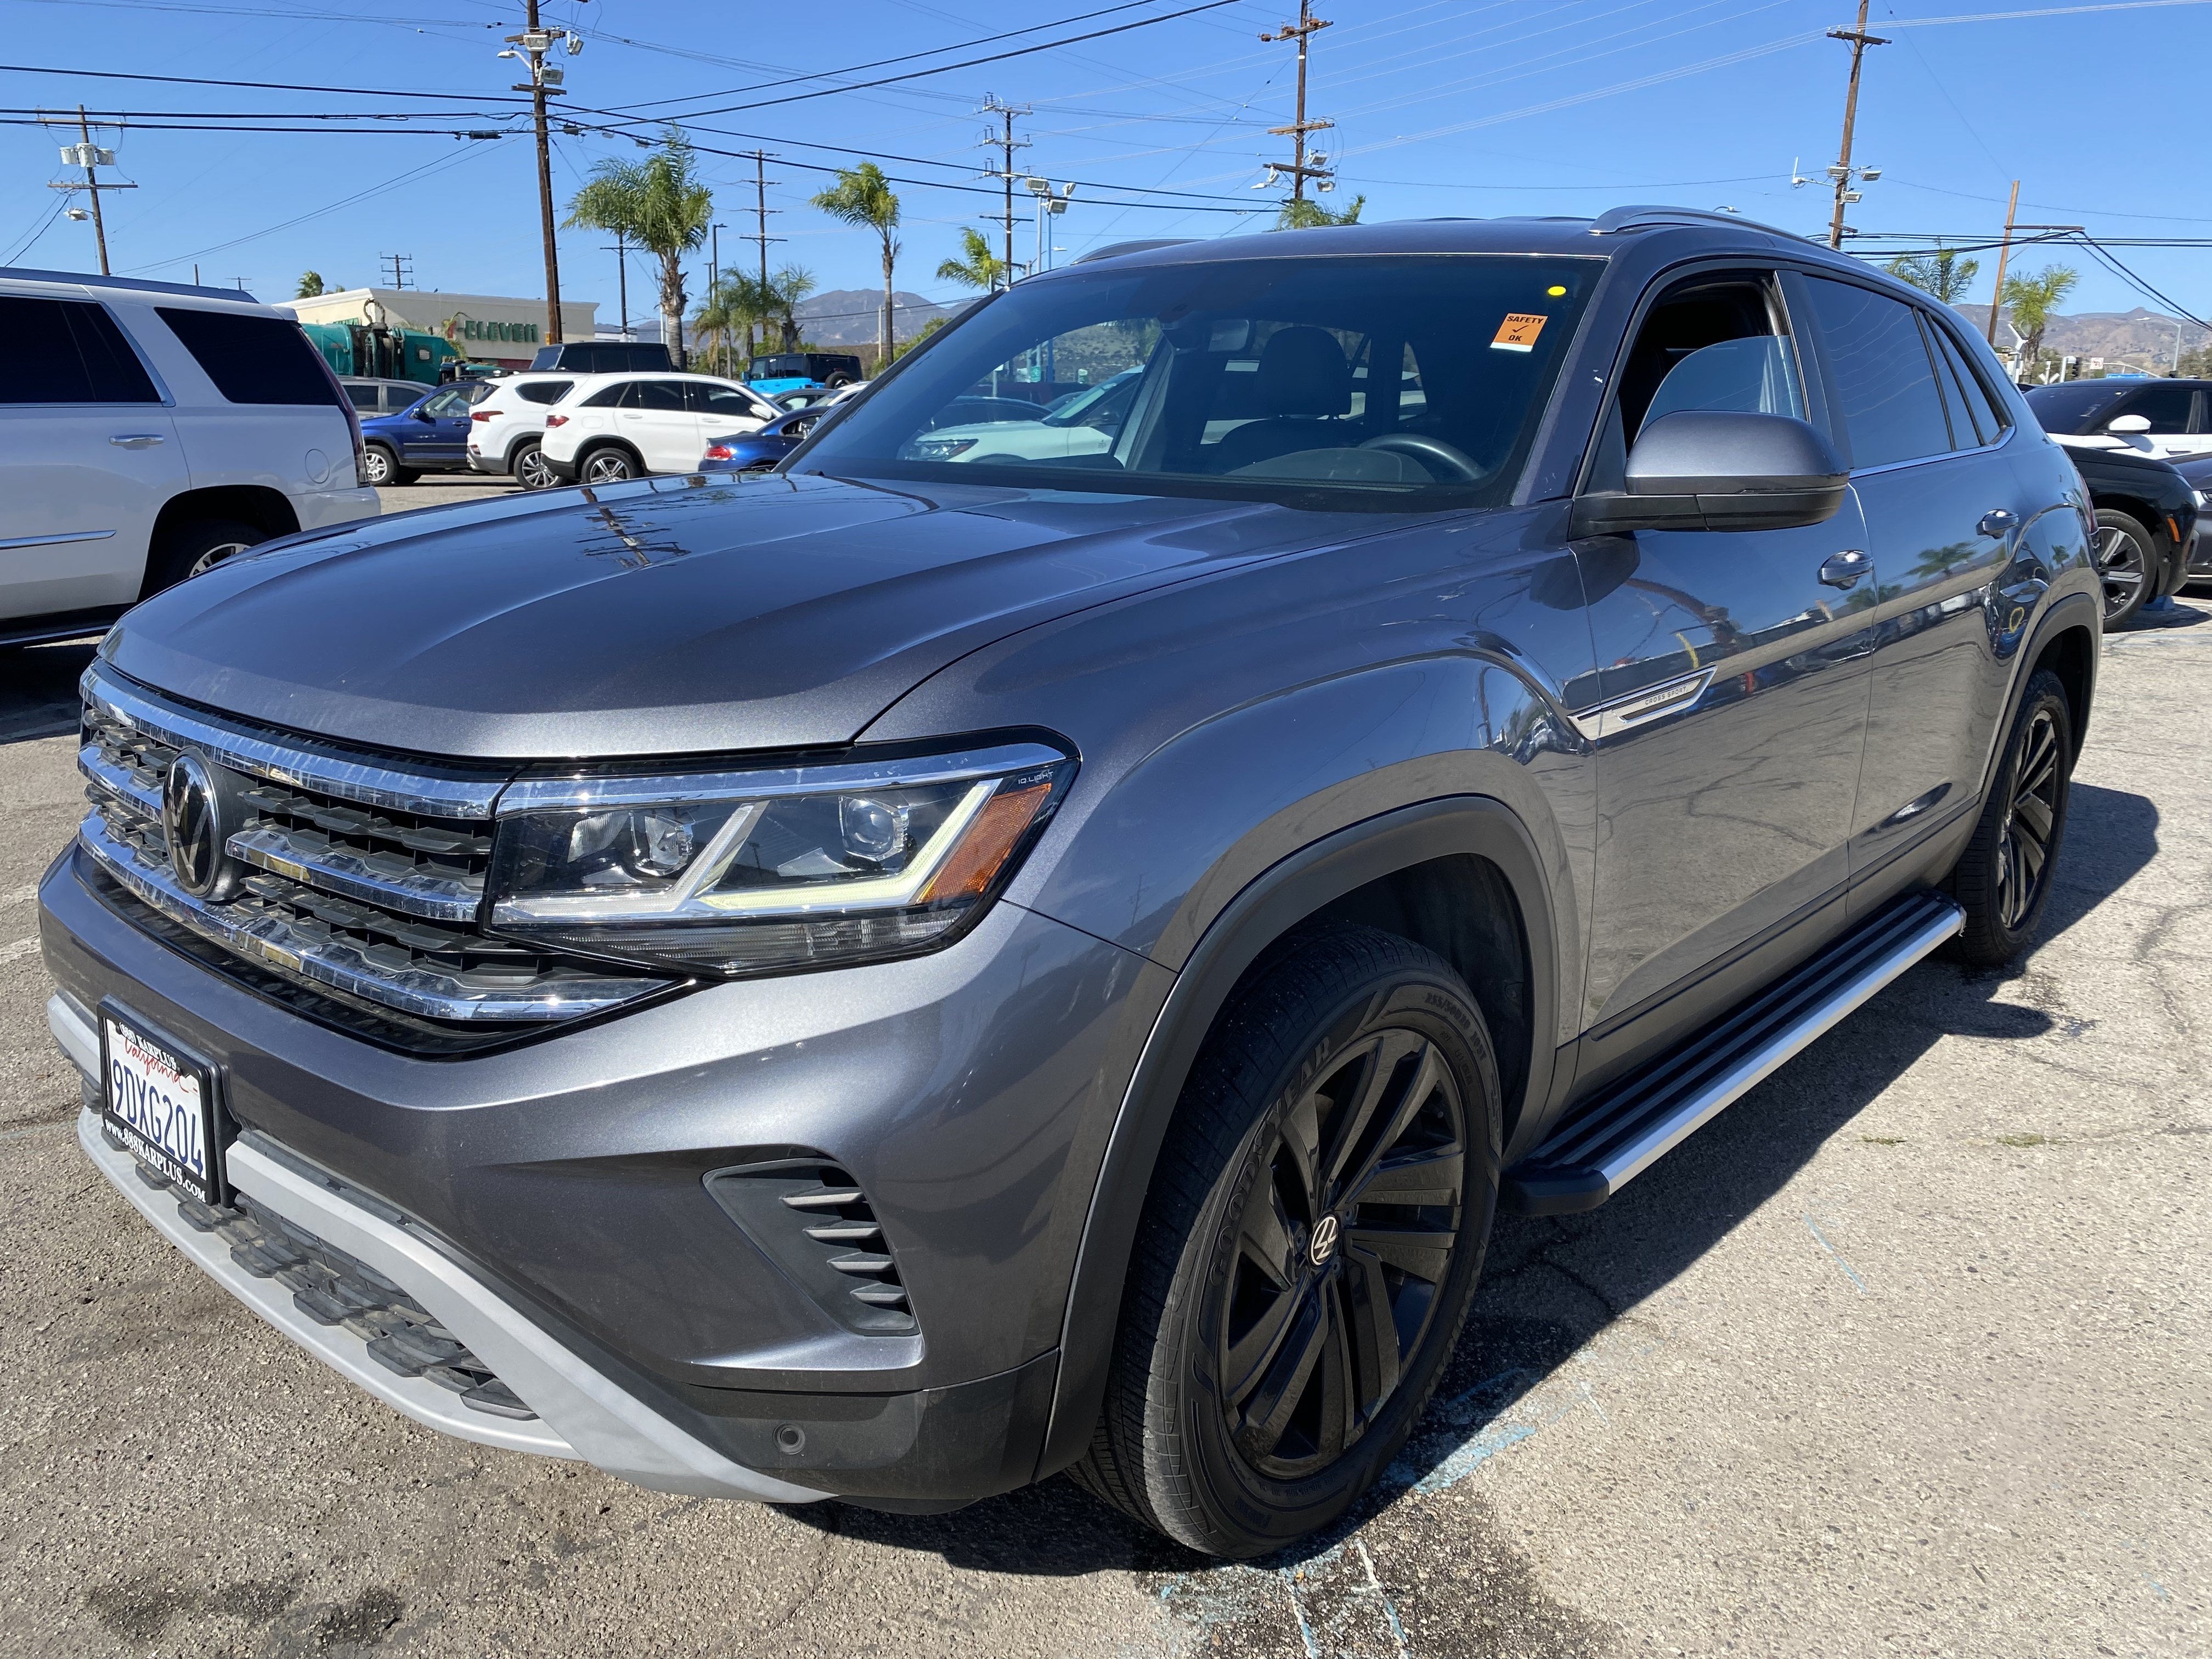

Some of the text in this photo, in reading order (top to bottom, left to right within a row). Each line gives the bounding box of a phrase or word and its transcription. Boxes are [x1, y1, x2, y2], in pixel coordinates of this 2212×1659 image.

[1506, 315, 1544, 324] SAFETY
[1645, 686, 1686, 706] CROSS SPORT
[1018, 771, 1054, 785] IQ.LIGHT
[125, 1037, 189, 1093] California
[136, 1034, 177, 1071] KARPLUS
[112, 1058, 204, 1178] 9DXG204
